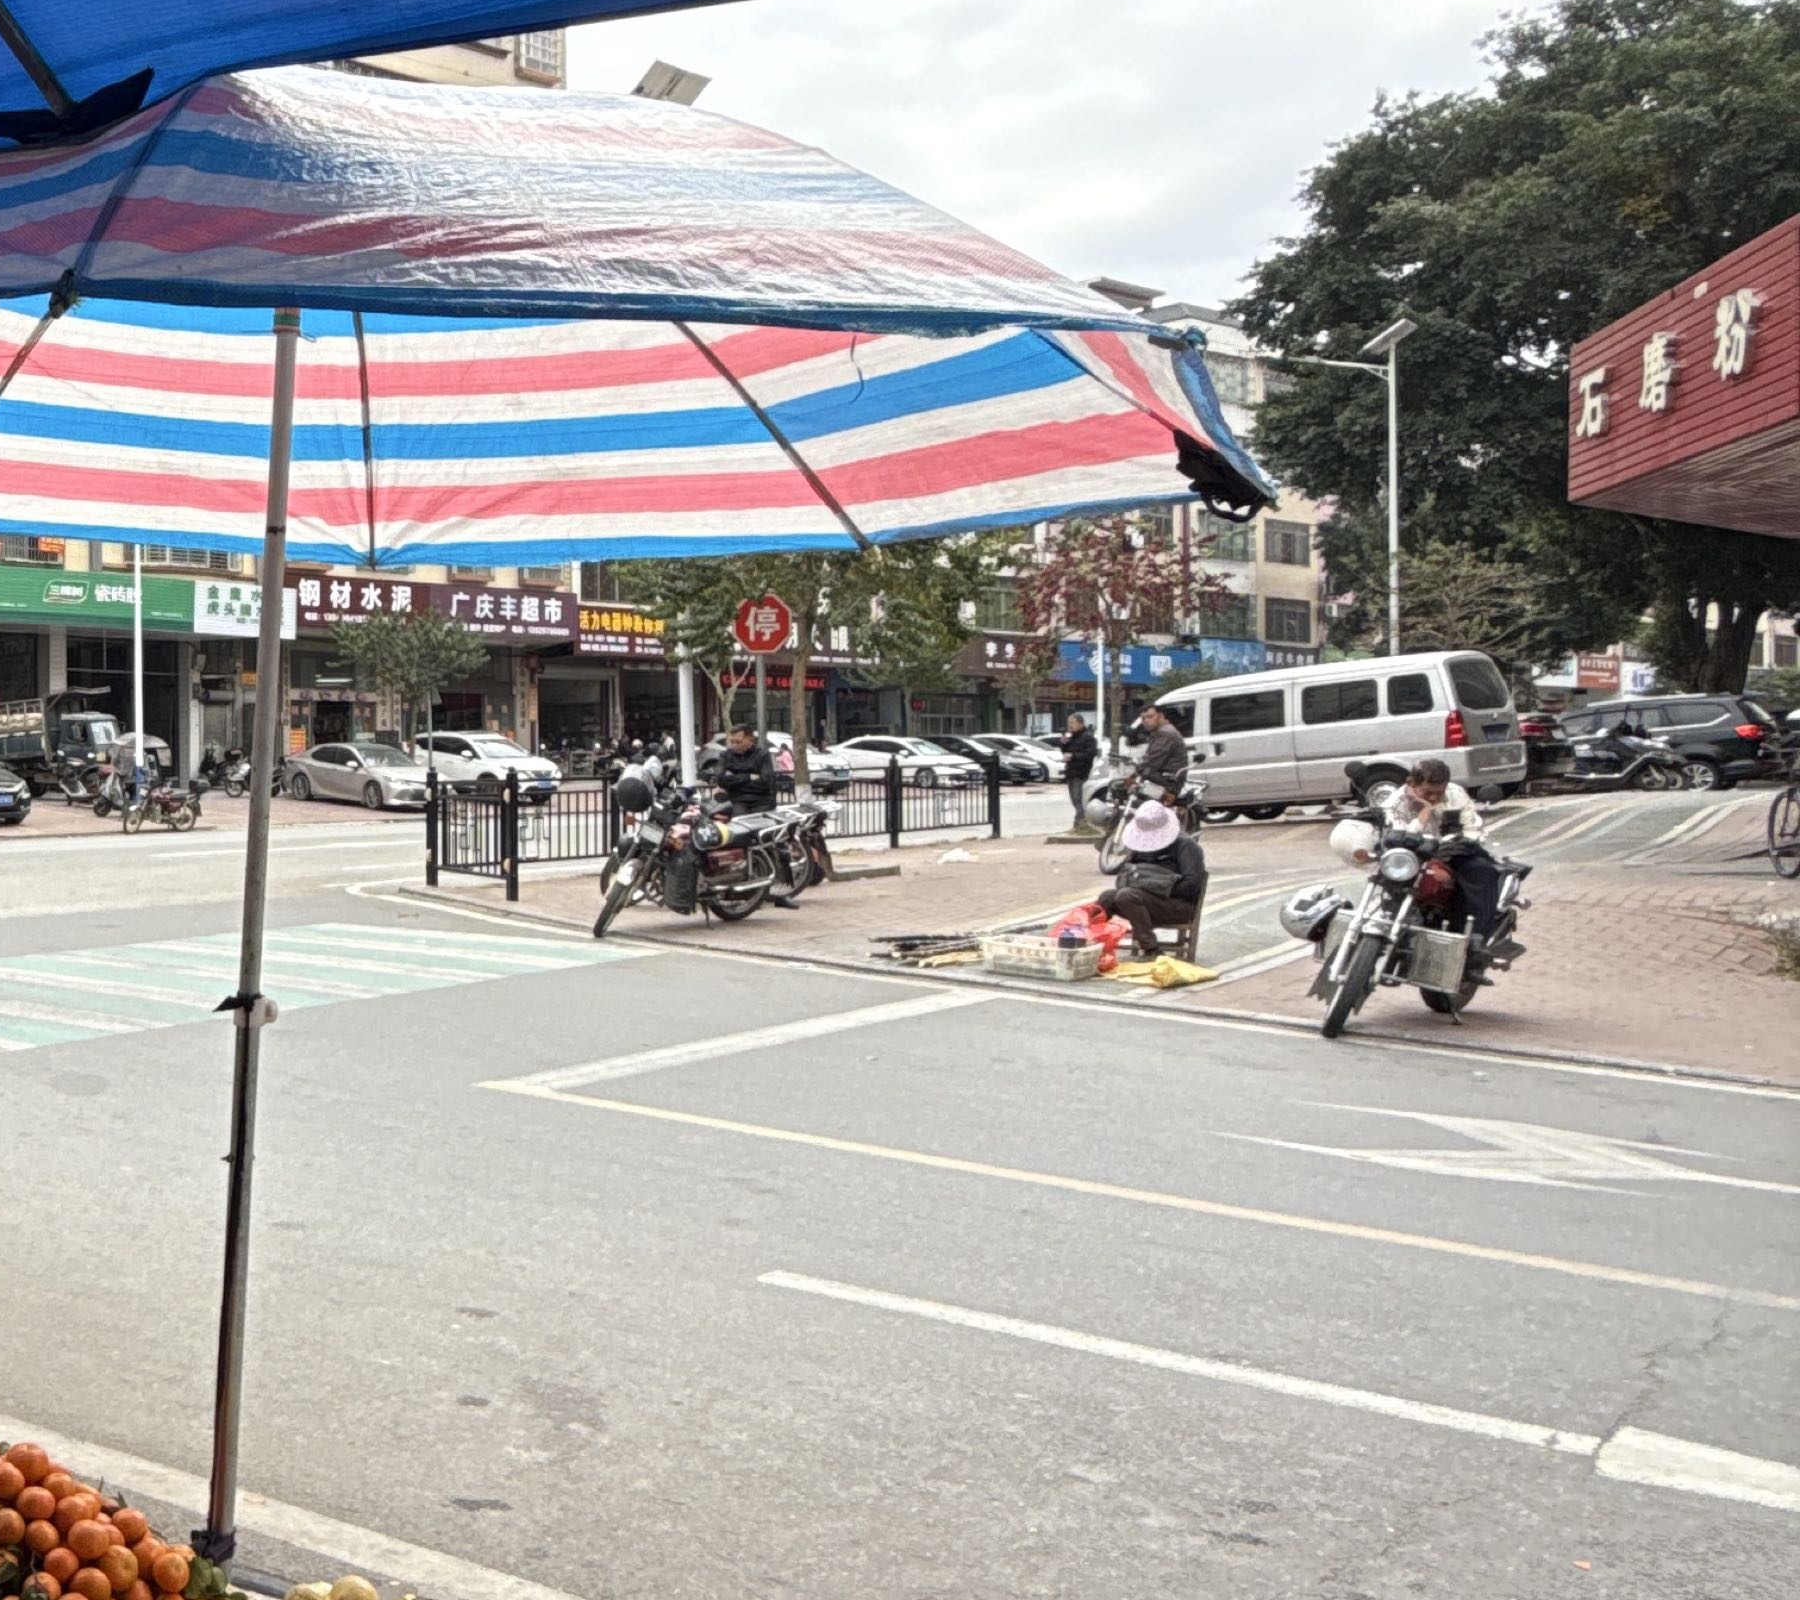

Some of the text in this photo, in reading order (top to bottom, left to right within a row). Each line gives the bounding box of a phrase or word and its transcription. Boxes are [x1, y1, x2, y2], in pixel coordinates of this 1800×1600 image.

[1575, 287, 1763, 438] 石磨粉
[206, 583, 283, 607] 金鹰水
[298, 578, 413, 613] 钢材水泥
[450, 590, 563, 625] 广庆丰超市
[744, 605, 781, 642] 停
